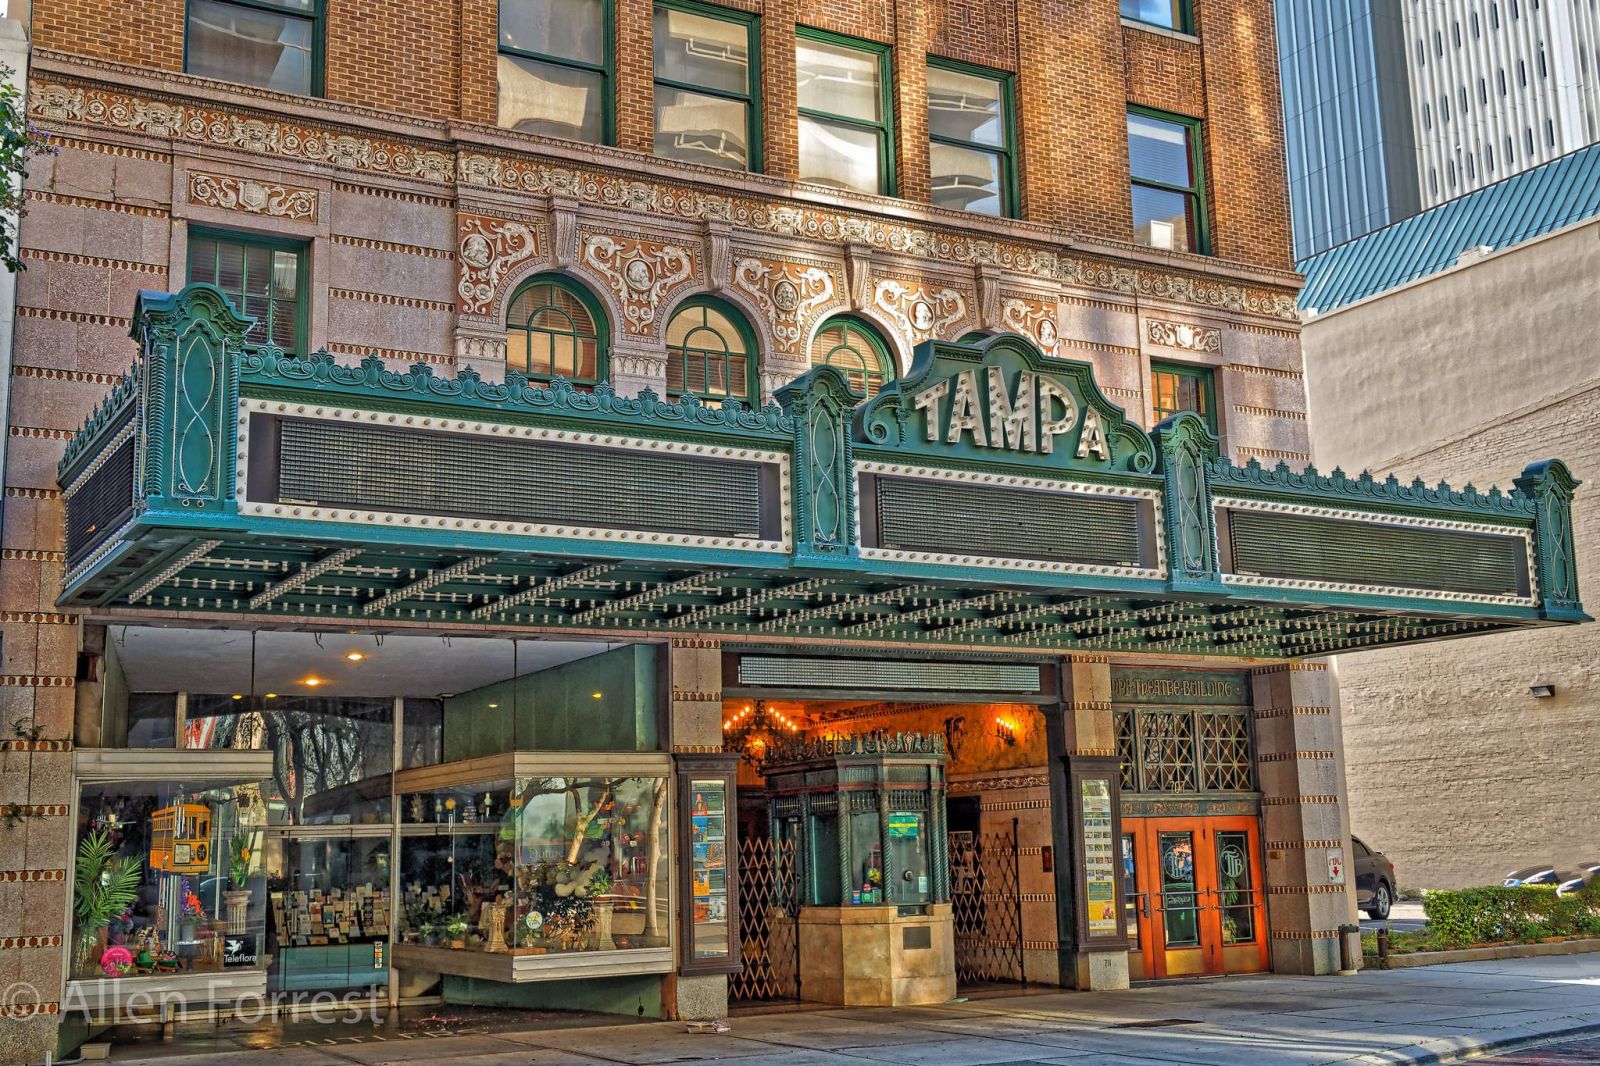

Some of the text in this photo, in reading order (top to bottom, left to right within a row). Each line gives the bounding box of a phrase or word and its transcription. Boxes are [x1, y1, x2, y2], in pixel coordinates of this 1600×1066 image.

[914, 366, 1110, 460] TAMPA
[1182, 680, 1232, 698] BUILDING
[223, 953, 257, 963] Teleflora
